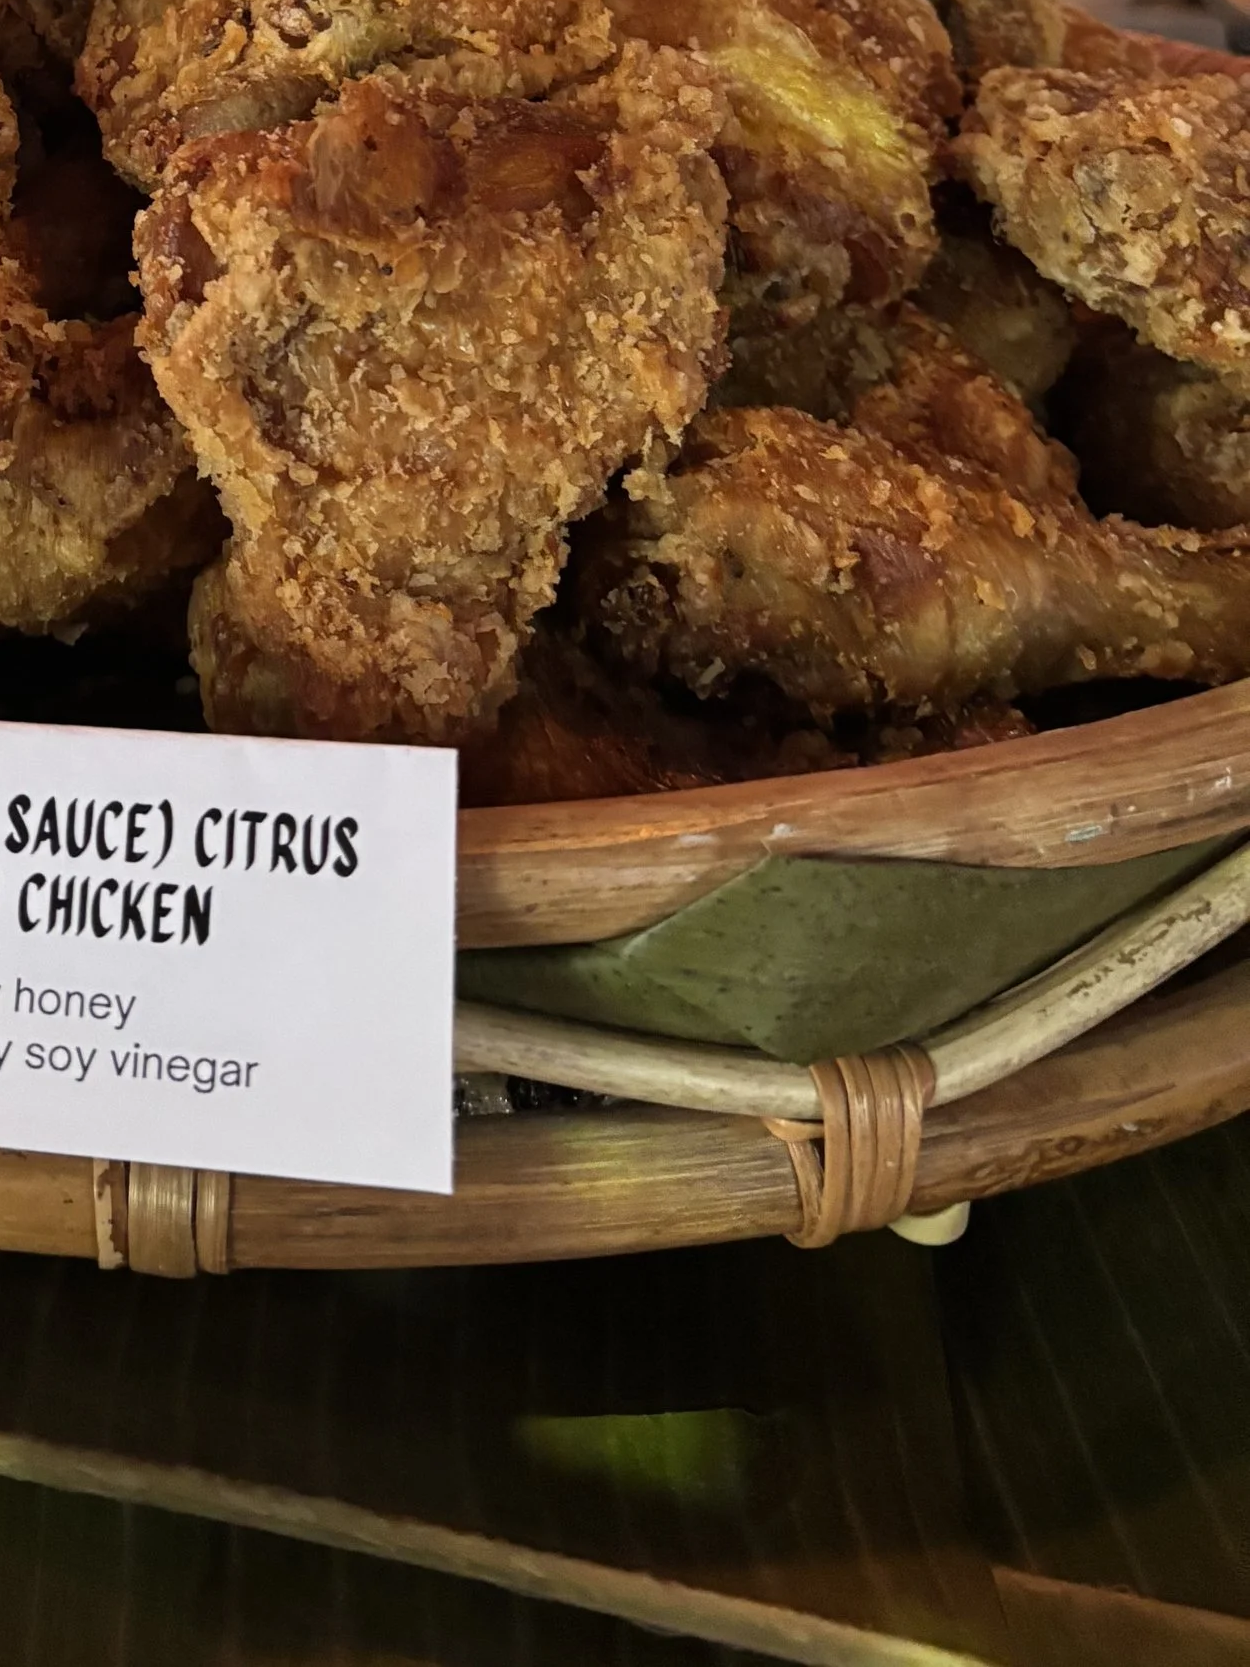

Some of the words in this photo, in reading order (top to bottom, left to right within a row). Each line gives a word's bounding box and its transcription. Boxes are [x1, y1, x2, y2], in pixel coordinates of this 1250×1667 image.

[4, 794, 175, 869] SAUCE)
[194, 807, 360, 878] CITRUS
[18, 872, 214, 946] CHICKEN
[14, 977, 137, 1032] honey
[25, 1042, 98, 1082] soy
[109, 1043, 260, 1095] vinegar
